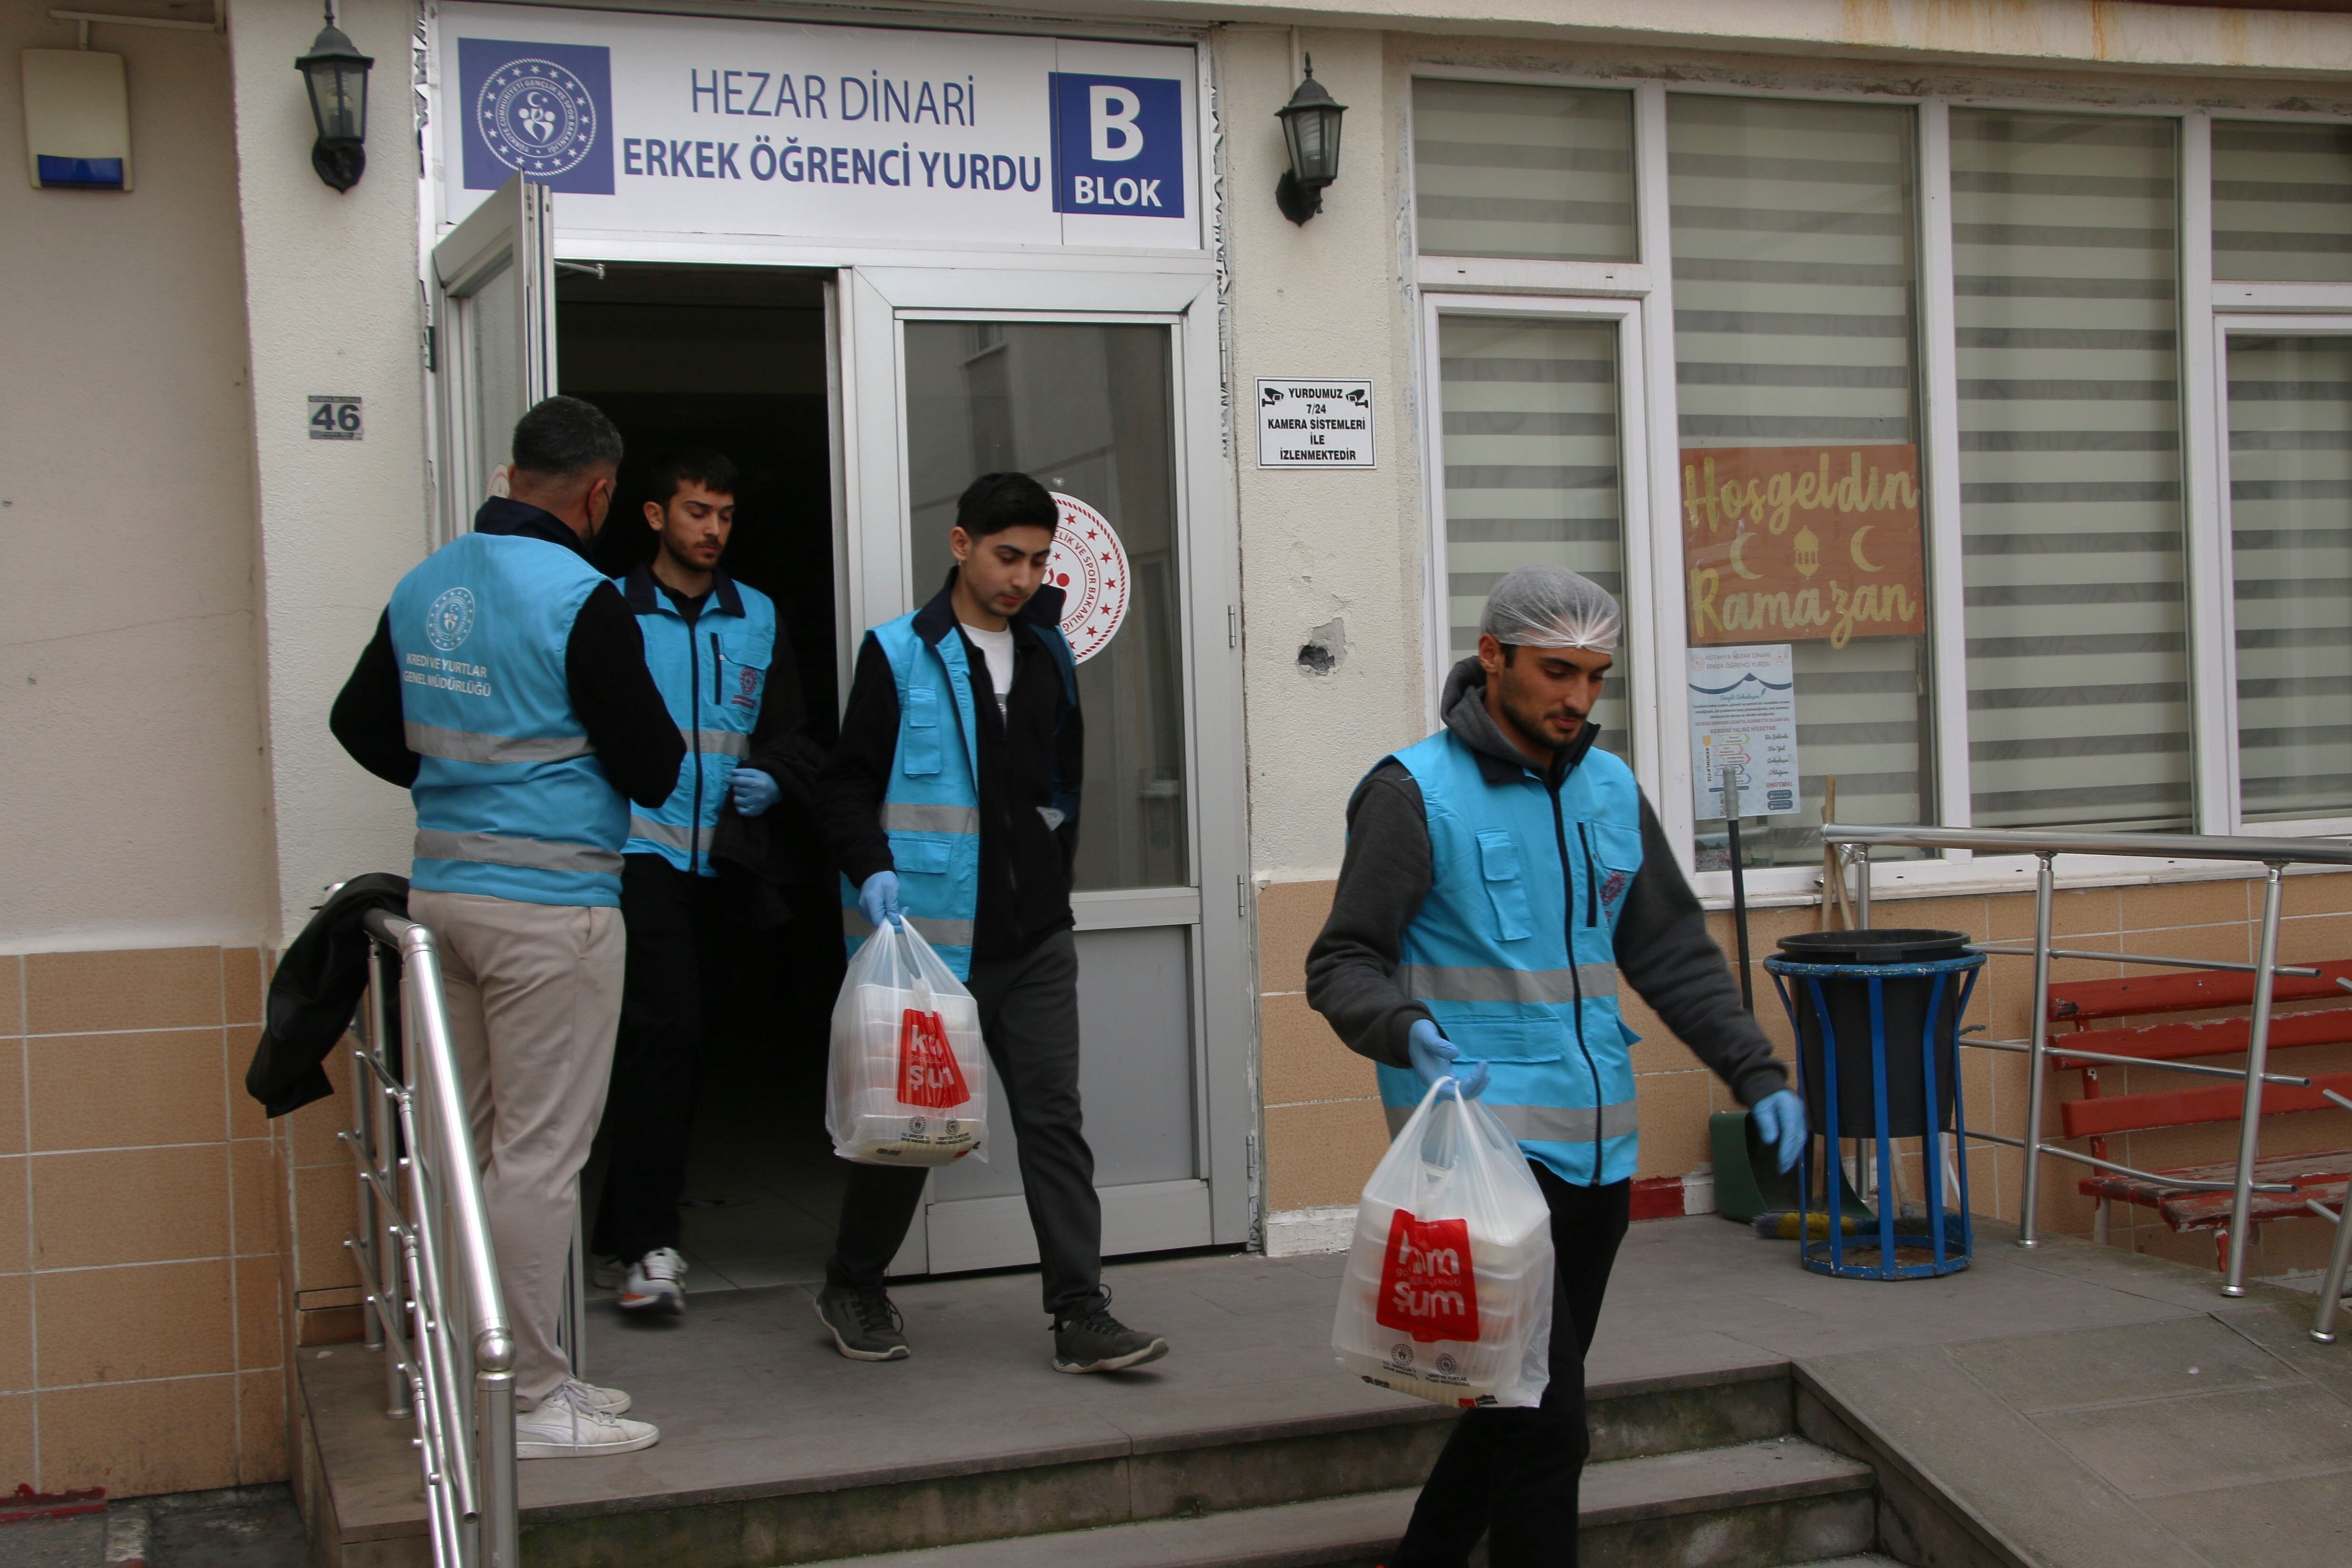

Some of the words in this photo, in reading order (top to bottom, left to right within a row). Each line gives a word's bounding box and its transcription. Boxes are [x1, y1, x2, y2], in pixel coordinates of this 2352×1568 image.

[524, 79, 557, 92] GENÇLİK
[557, 90, 566, 101] VE
[691, 68, 828, 120] HEZAR
[840, 69, 975, 126] DİNARİ
[564, 100, 575, 119] SPOR
[1089, 85, 1144, 162] B
[547, 121, 575, 153] BAKANLIĞI
[623, 137, 742, 180] ERKEK
[750, 134, 910, 186] ÖĞRENCİ
[918, 150, 1041, 192] YURDU
[1074, 175, 1163, 207] BLOK
[1288, 387, 1343, 399] YURDUMUZ
[311, 403, 361, 432] 46
[1306, 404, 1326, 415] 7/24
[1268, 418, 1308, 429] KAMERA
[1310, 416, 1365, 430] SİSTEMLERİ
[1310, 432, 1325, 445] İLE
[1280, 447, 1356, 460] İZLENMEKTEDİR
[1053, 530, 1075, 546] ÇLİK
[1074, 542, 1087, 556] VE
[1082, 556, 1097, 584] SPOR
[1061, 587, 1097, 632] BAKANLIĞ
[1690, 567, 1917, 649] Ramazan
[406, 652, 429, 668] KREDİ
[429, 657, 441, 669] VE
[441, 658, 488, 678] YURTLAR
[403, 670, 427, 685] GENEL
[427, 673, 492, 697] MÜDÜRLÜĞÜ
